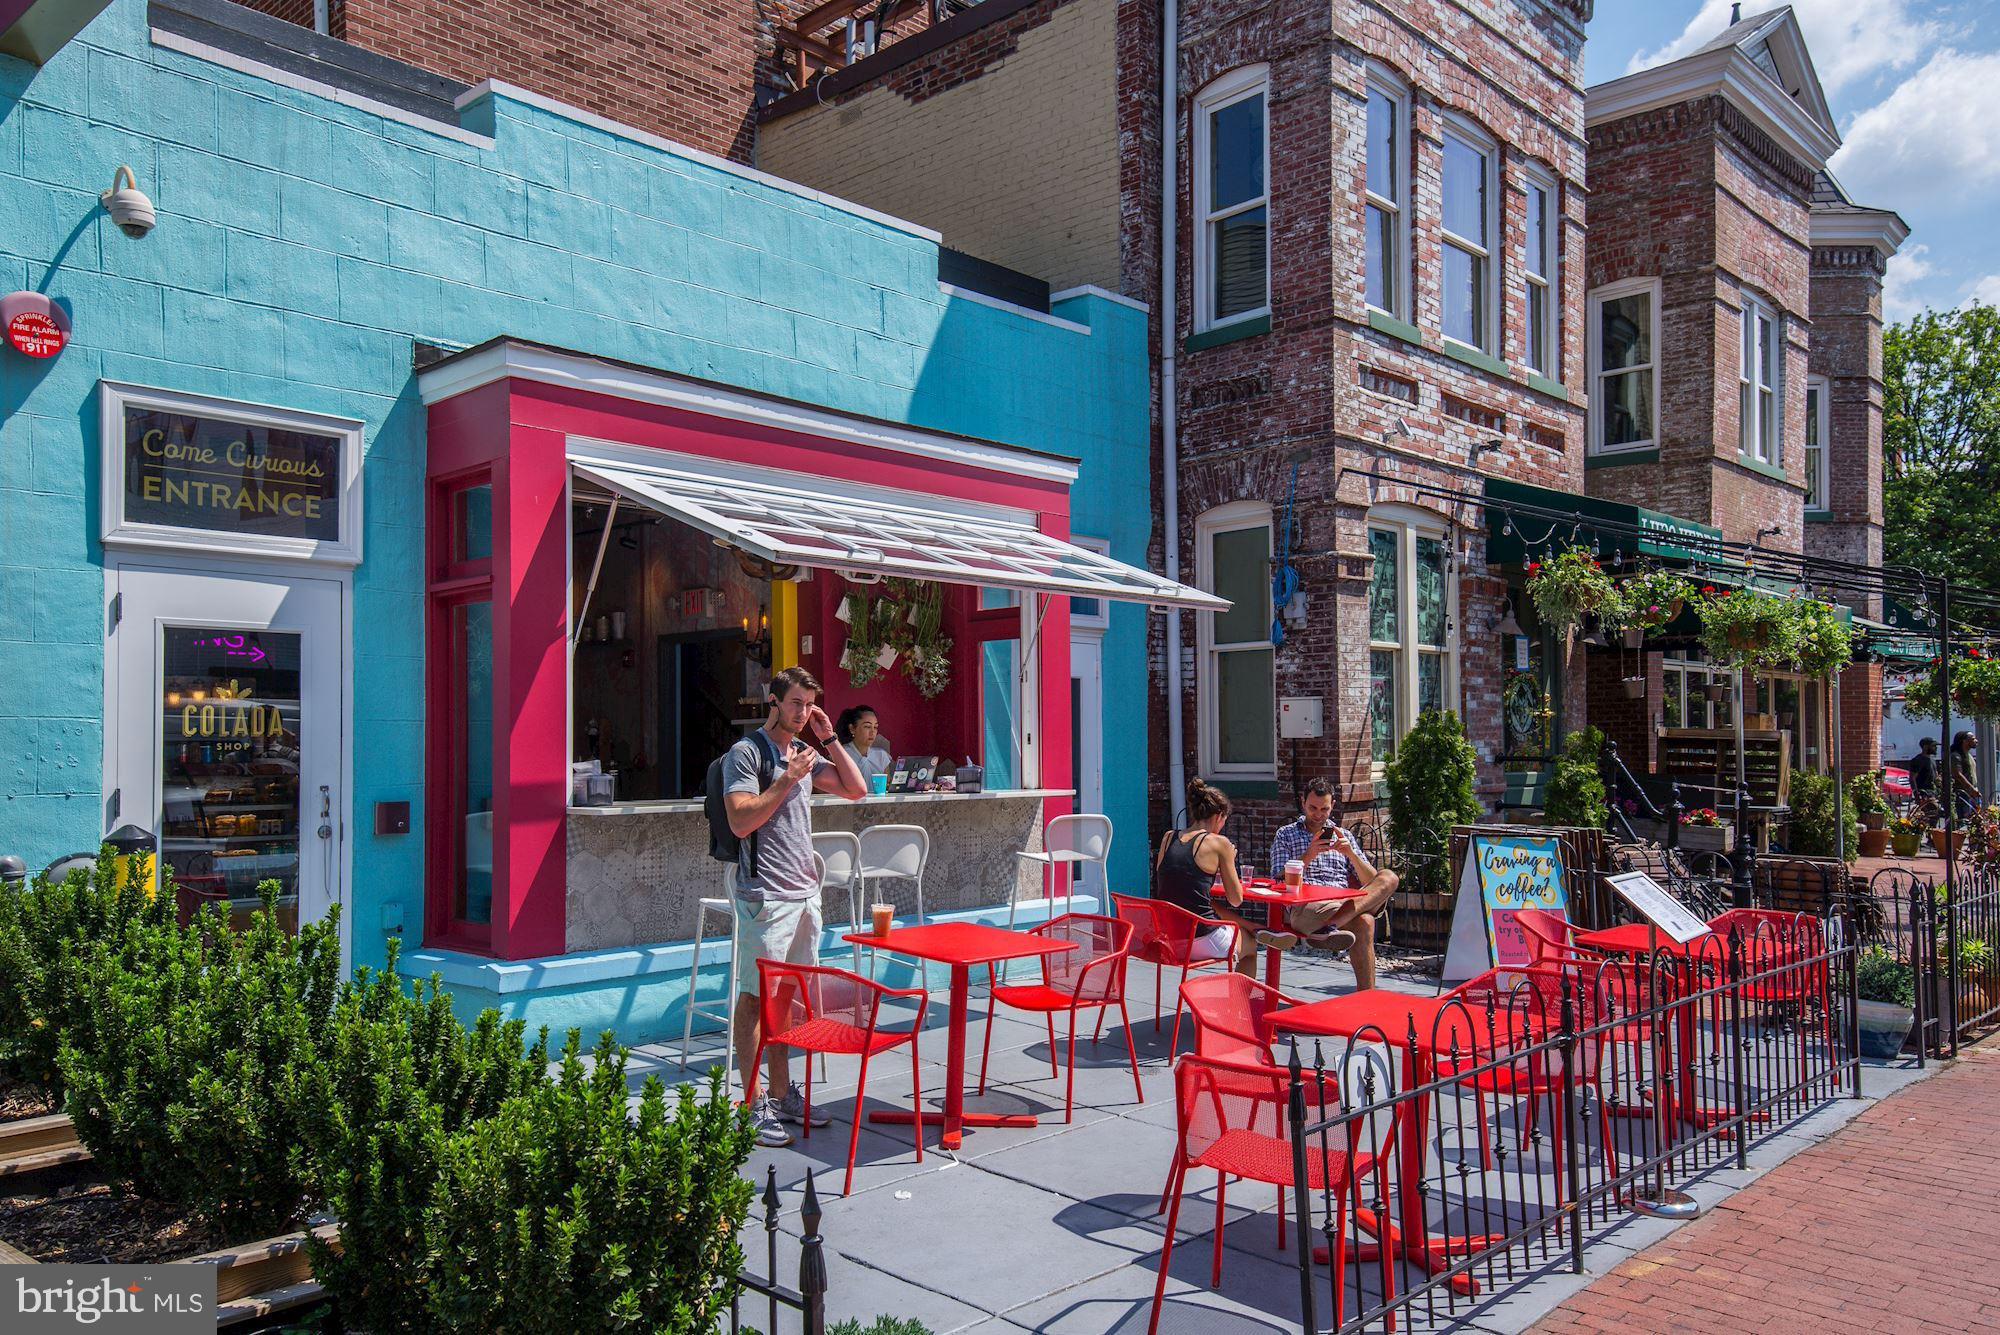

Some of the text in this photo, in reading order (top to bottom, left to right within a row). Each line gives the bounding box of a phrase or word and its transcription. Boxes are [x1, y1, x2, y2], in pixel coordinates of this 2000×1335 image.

[13, 323, 60, 335] FIRE ALARM
[16, 313, 56, 328] SPRINKLER
[142, 429, 325, 478] Come Curious
[143, 475, 321, 519] ENTRANCE
[684, 591, 704, 617] EXIT
[182, 704, 283, 737] COLADA
[216, 742, 251, 751] SHOP
[1484, 846, 1556, 876] Craving a
[1500, 877, 1549, 901] coffee?
[1499, 926, 1511, 937] try
